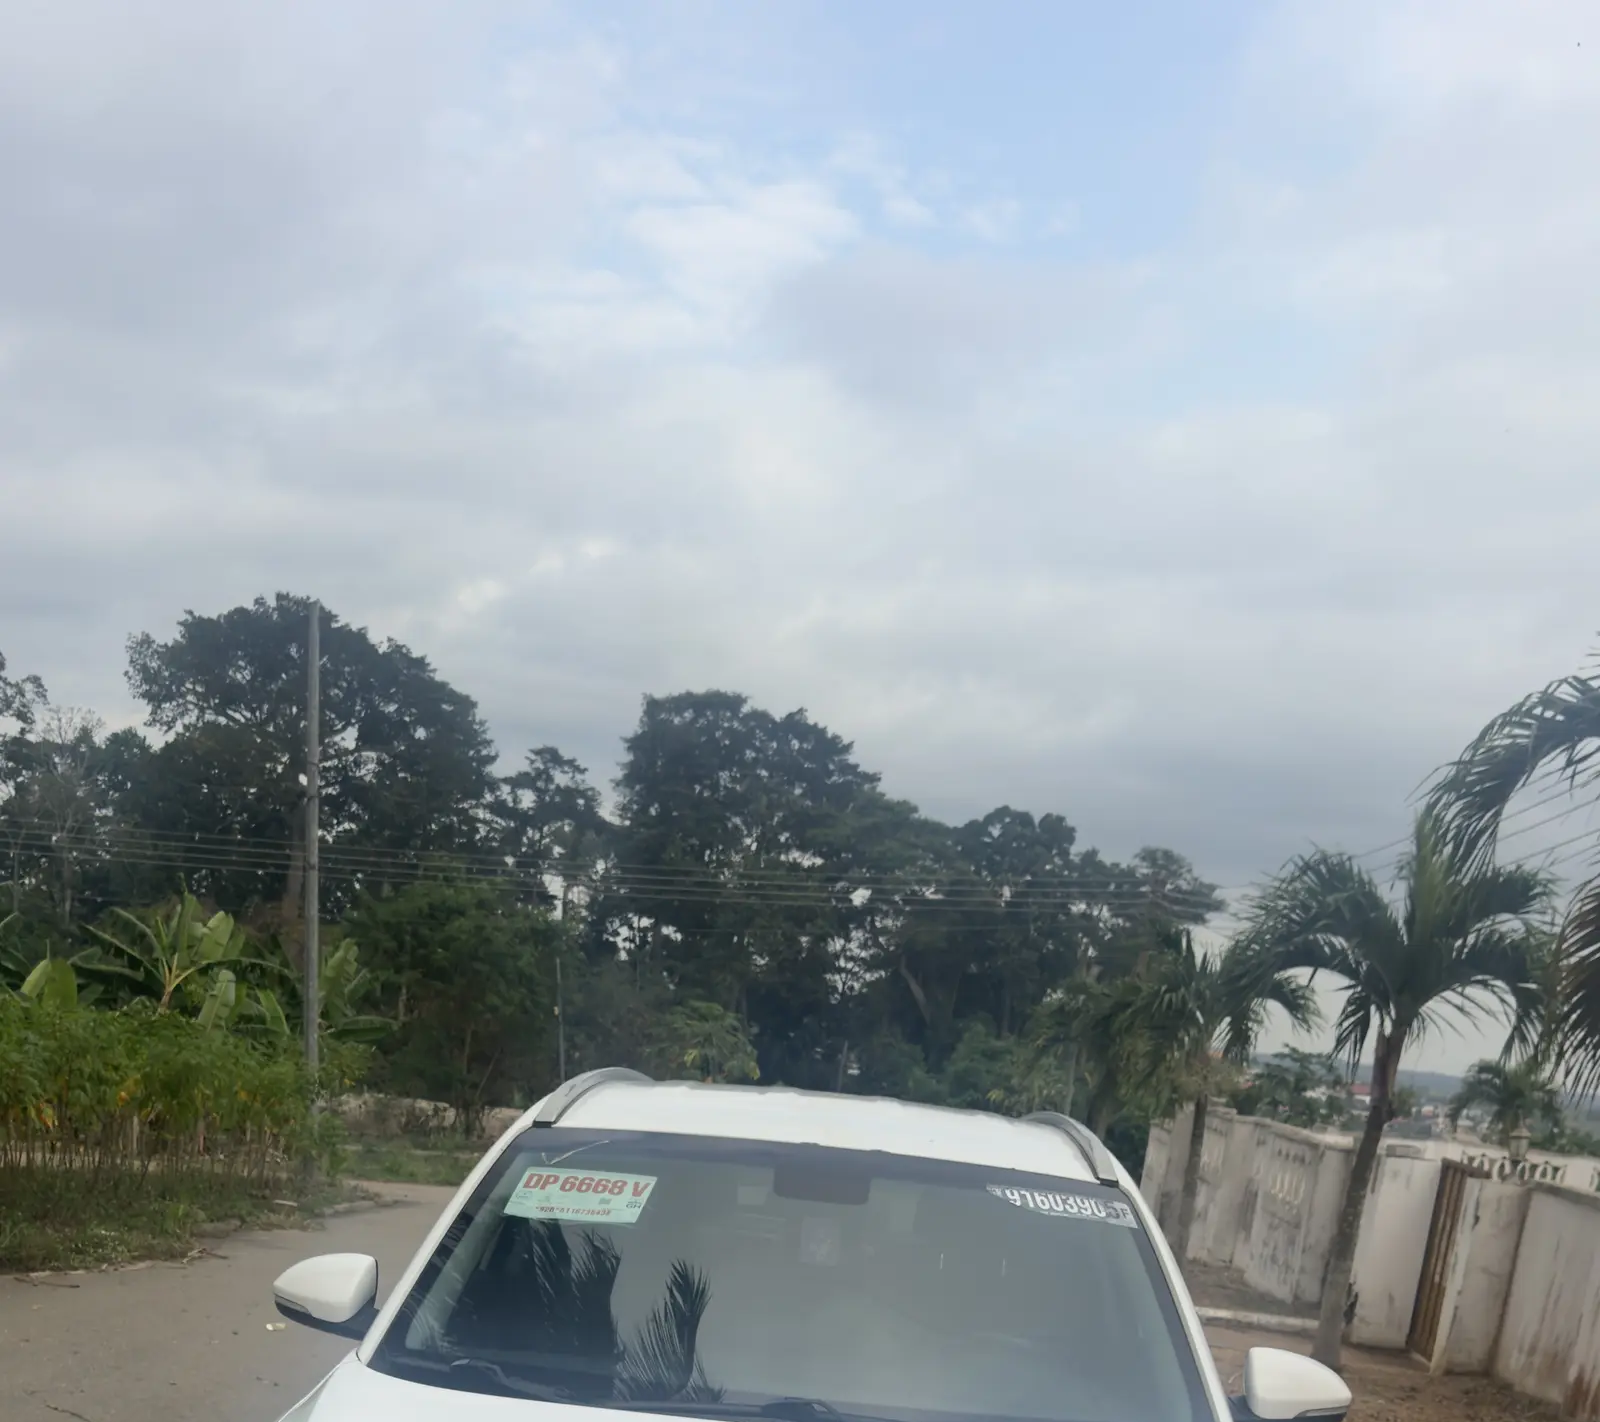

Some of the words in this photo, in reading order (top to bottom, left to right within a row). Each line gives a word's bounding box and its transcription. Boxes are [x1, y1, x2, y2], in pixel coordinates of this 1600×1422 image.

[523, 1173, 560, 1191] DP
[559, 1175, 628, 1196] 6668
[631, 1181, 651, 1198] V
